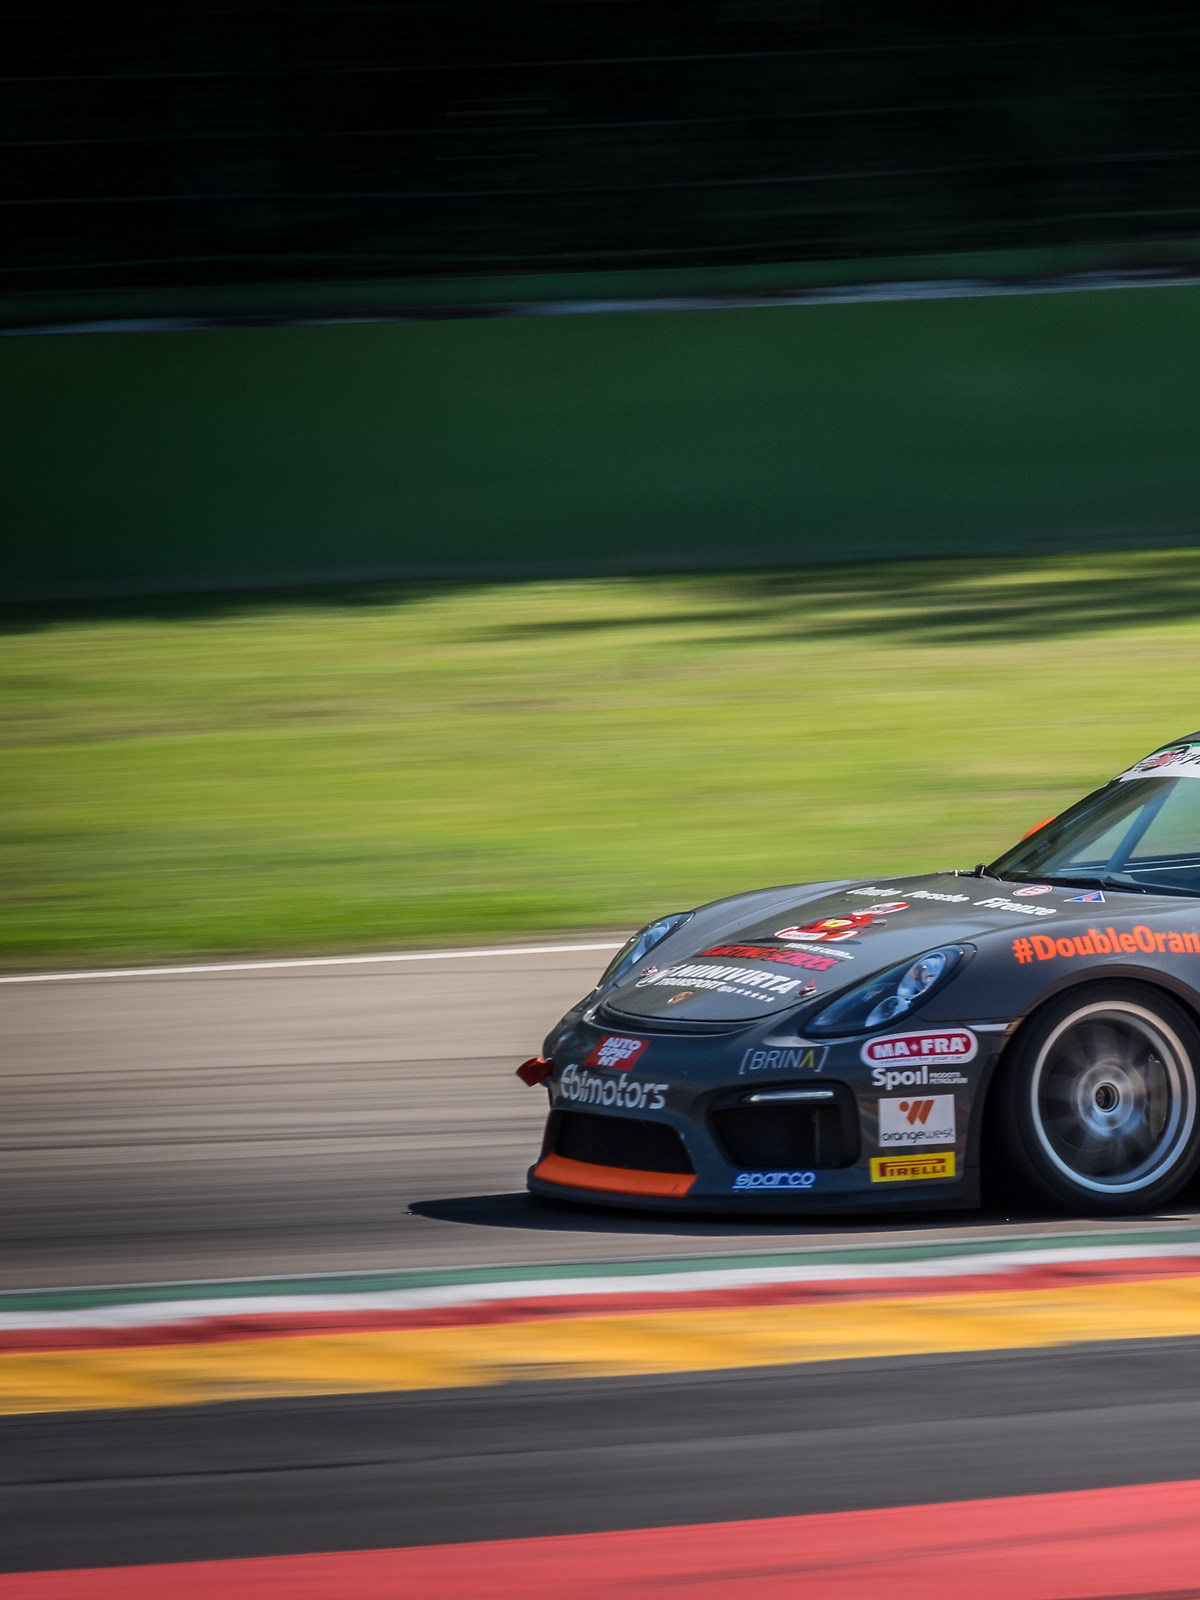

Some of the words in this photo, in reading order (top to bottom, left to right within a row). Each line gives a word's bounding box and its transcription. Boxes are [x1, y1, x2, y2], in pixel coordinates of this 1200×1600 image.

[973, 897, 1058, 916] Firenze
[670, 964, 802, 994] NIINIVIRTA
[602, 1037, 642, 1051] AUTO
[560, 1064, 669, 1110] Ebimotors
[871, 1065, 928, 1091] Spoil
[882, 1127, 954, 1143] orangewest
[878, 1158, 946, 1177] PIRELLI
[735, 1171, 816, 1190] sparco
